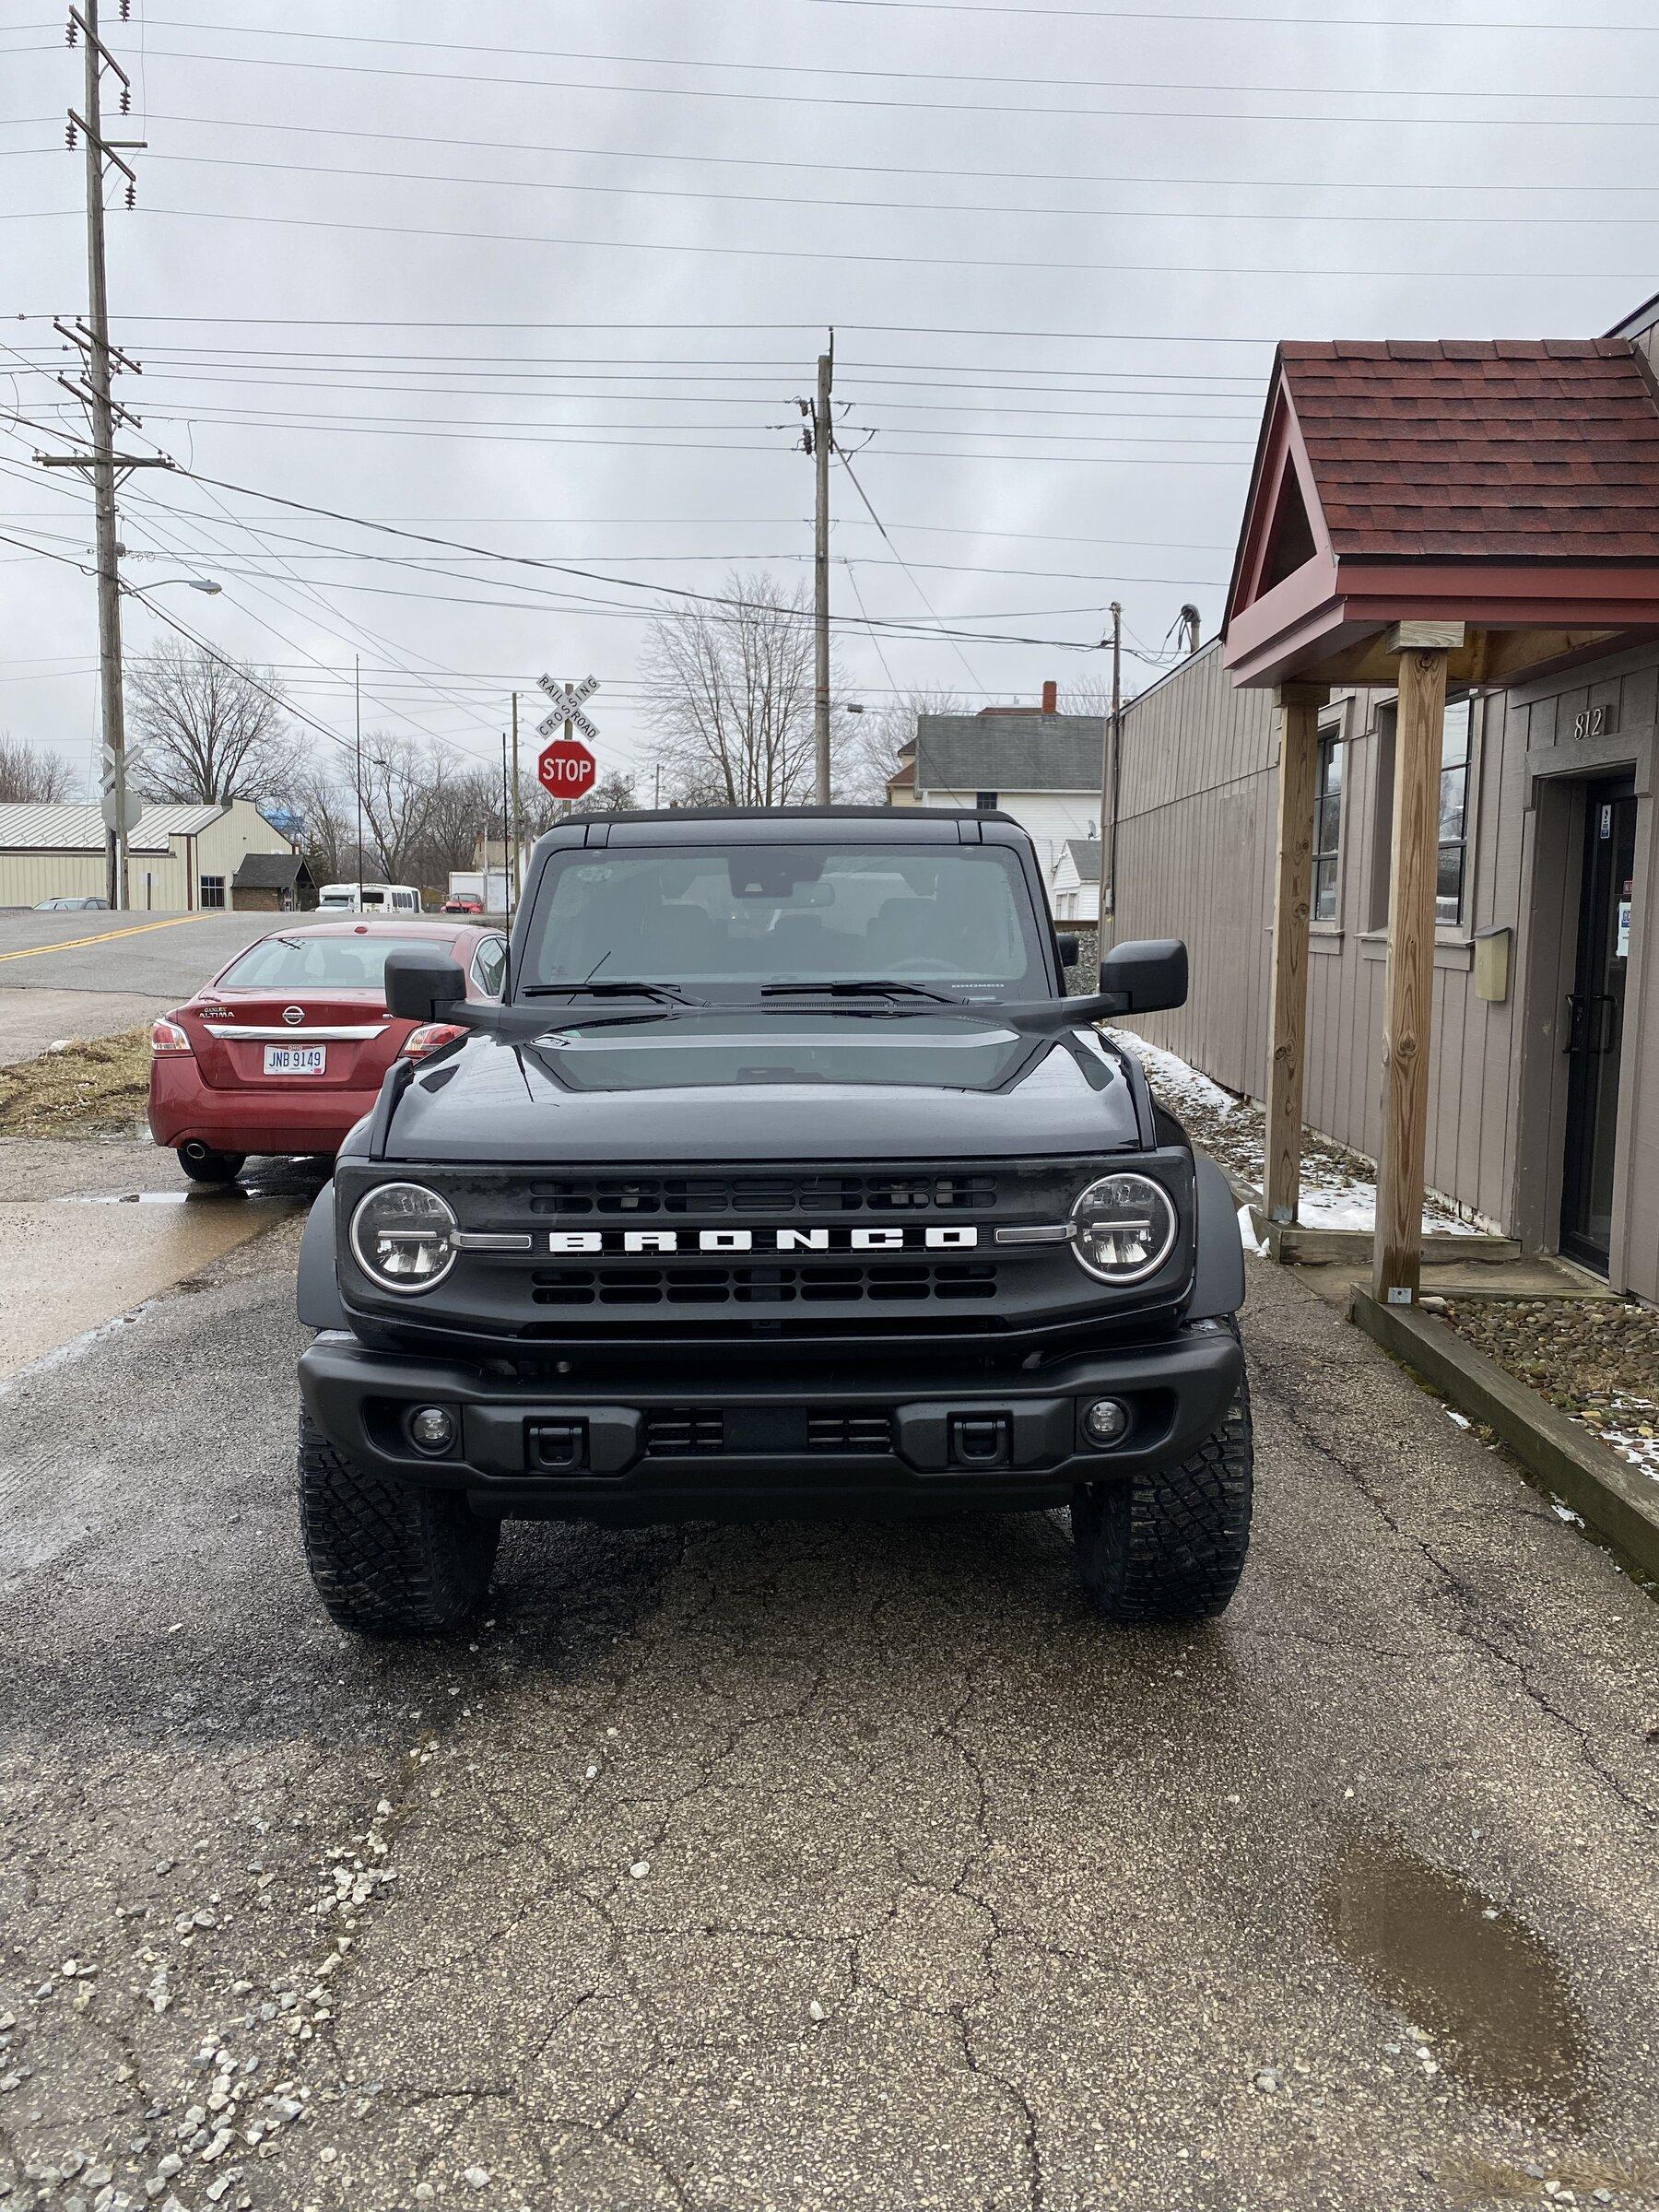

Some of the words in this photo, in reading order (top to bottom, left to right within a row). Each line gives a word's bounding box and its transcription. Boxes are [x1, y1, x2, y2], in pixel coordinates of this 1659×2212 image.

[539, 678, 597, 735] CROSSING
[1574, 708, 1602, 740] 812
[542, 758, 592, 782] STOP
[269, 1052, 289, 1067] JNB
[293, 1052, 321, 1067] 9149
[548, 1227, 978, 1253] BRONCO
